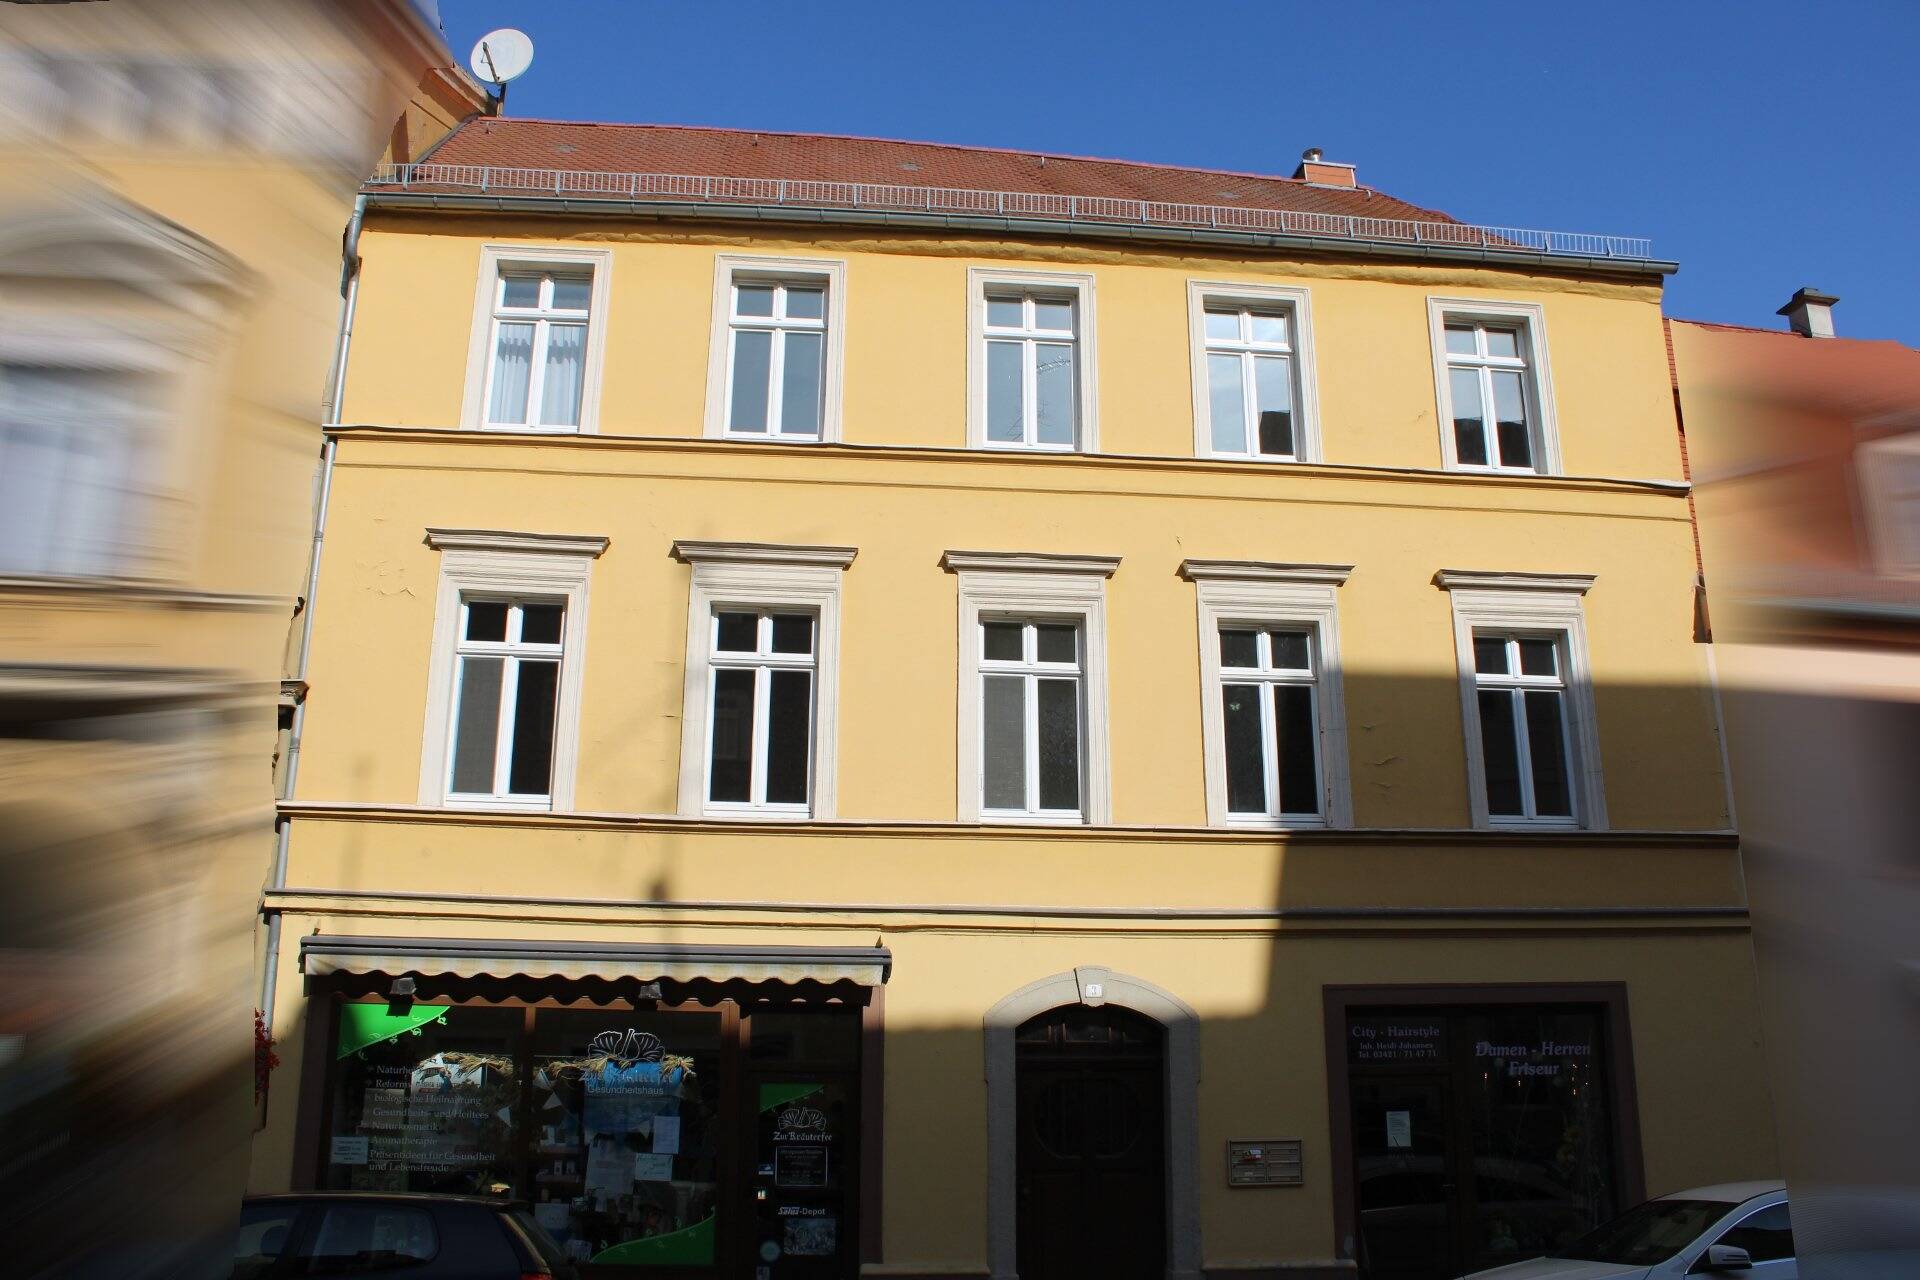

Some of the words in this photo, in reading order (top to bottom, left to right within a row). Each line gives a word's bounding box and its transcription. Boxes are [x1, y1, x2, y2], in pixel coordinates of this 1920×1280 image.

[1352, 1025, 1376, 1039] City
[1387, 1025, 1440, 1039] Hairstyle
[1475, 1041, 1525, 1057] Damen
[1541, 1041, 1591, 1057] Herren
[1508, 1061, 1558, 1076] Friseur
[586, 1085, 664, 1095] Gesundheitshaus
[371, 1121, 439, 1131] Naturkosmetik
[371, 1135, 438, 1147] Aromatherapie
[772, 1131, 788, 1142] Zur
[788, 1131, 832, 1143] Kräuterfee
[428, 1150, 442, 1160] für
[443, 1151, 496, 1162] Gesundheit
[368, 1162, 387, 1172] und
[389, 1162, 449, 1173] Lebensfreude
